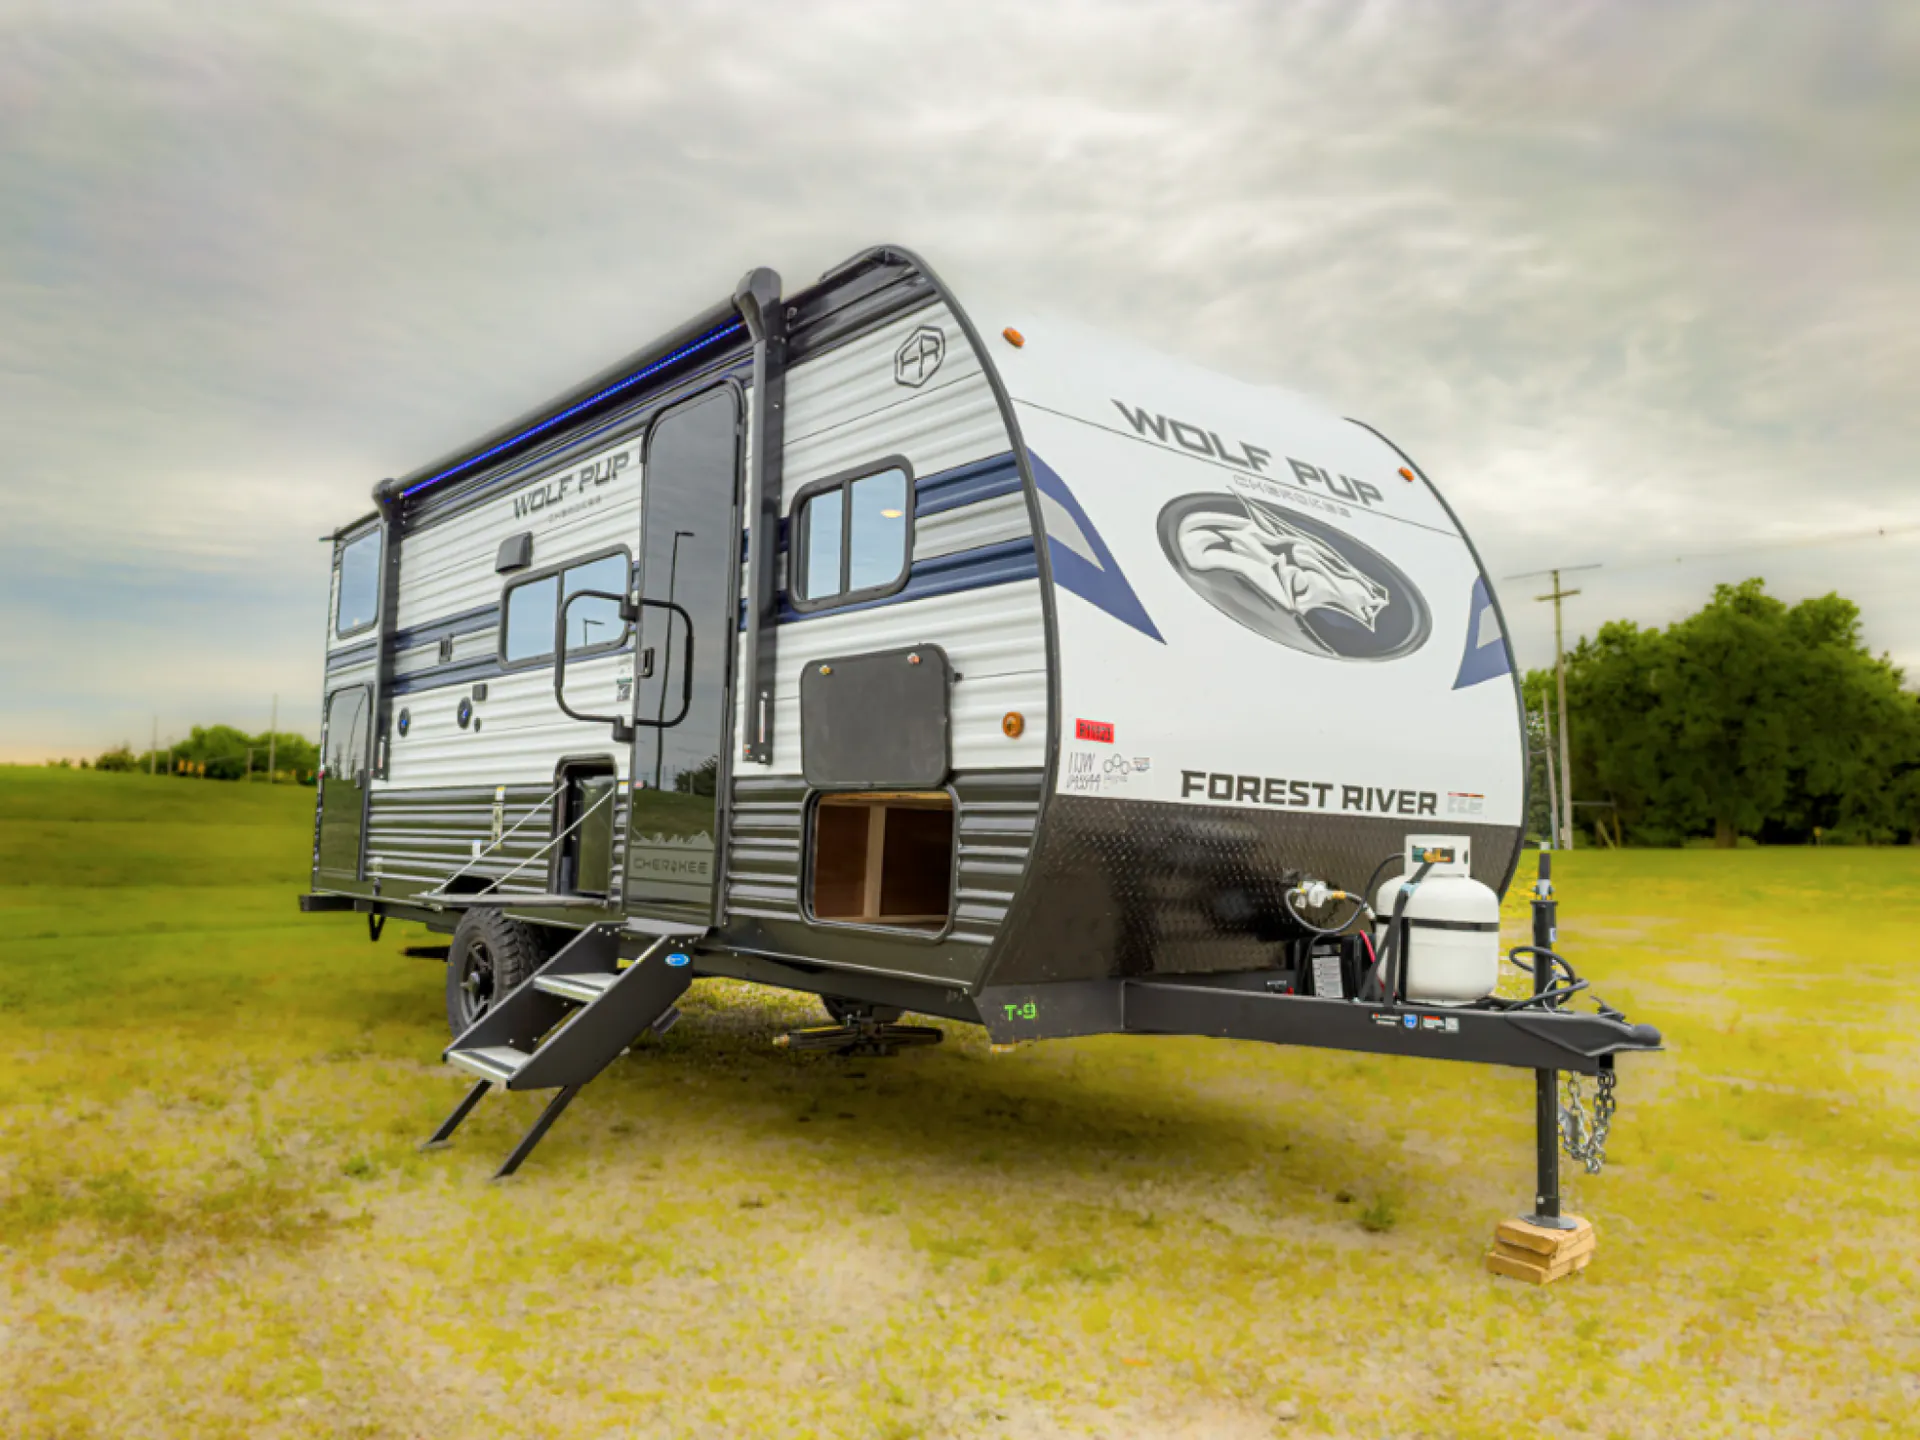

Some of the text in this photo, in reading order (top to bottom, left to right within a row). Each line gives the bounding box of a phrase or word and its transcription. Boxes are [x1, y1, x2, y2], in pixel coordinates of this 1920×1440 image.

[514, 451, 629, 519] WOLF PUP
[1110, 398, 1384, 506] WOLF PUP
[1181, 769, 1334, 808] FOREST
[1342, 785, 1438, 816] RIVER
